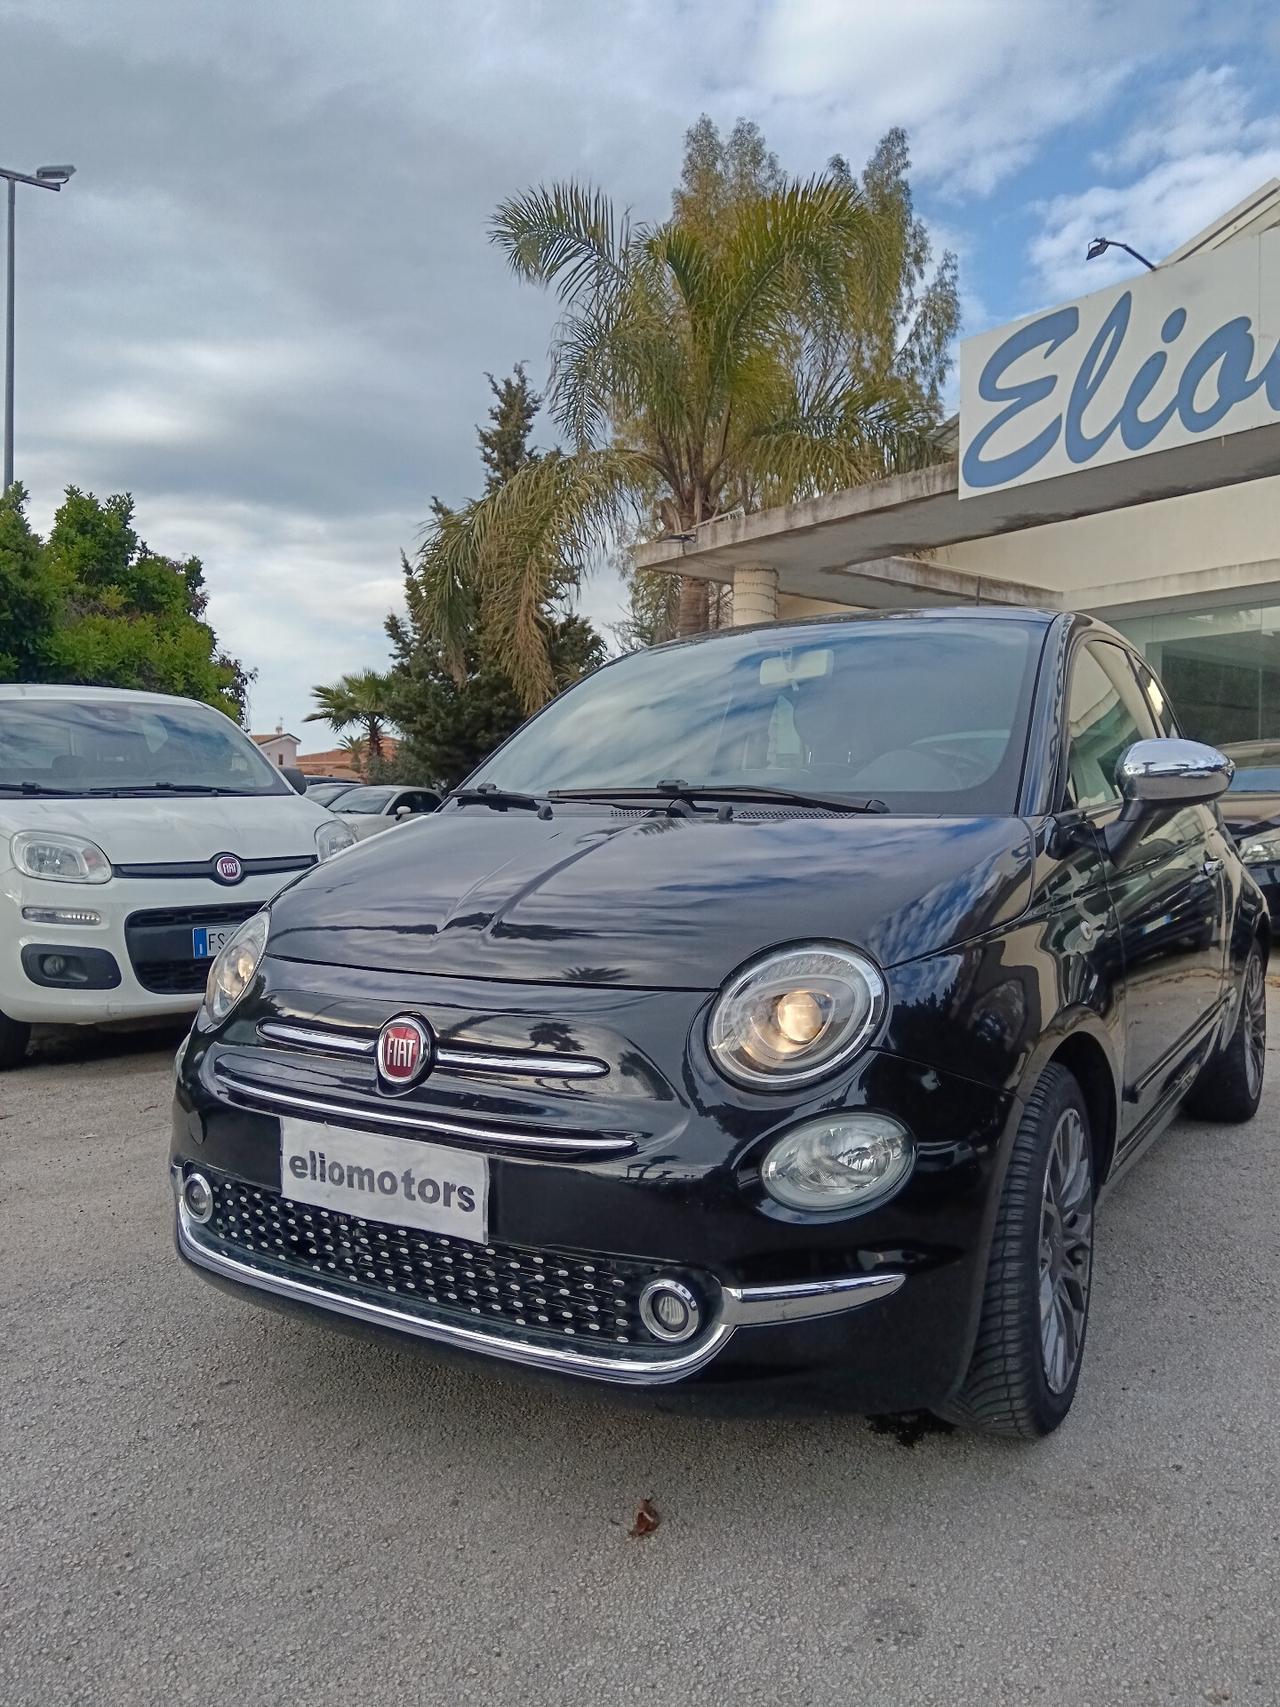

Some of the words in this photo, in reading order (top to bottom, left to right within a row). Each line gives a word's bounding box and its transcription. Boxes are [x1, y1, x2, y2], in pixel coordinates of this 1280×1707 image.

[962, 290, 1280, 487] Elio
[222, 862, 237, 874] FIAT
[208, 931, 234, 951] FS
[386, 1037, 416, 1068] FIAT
[289, 1150, 476, 1213] eliomotors
